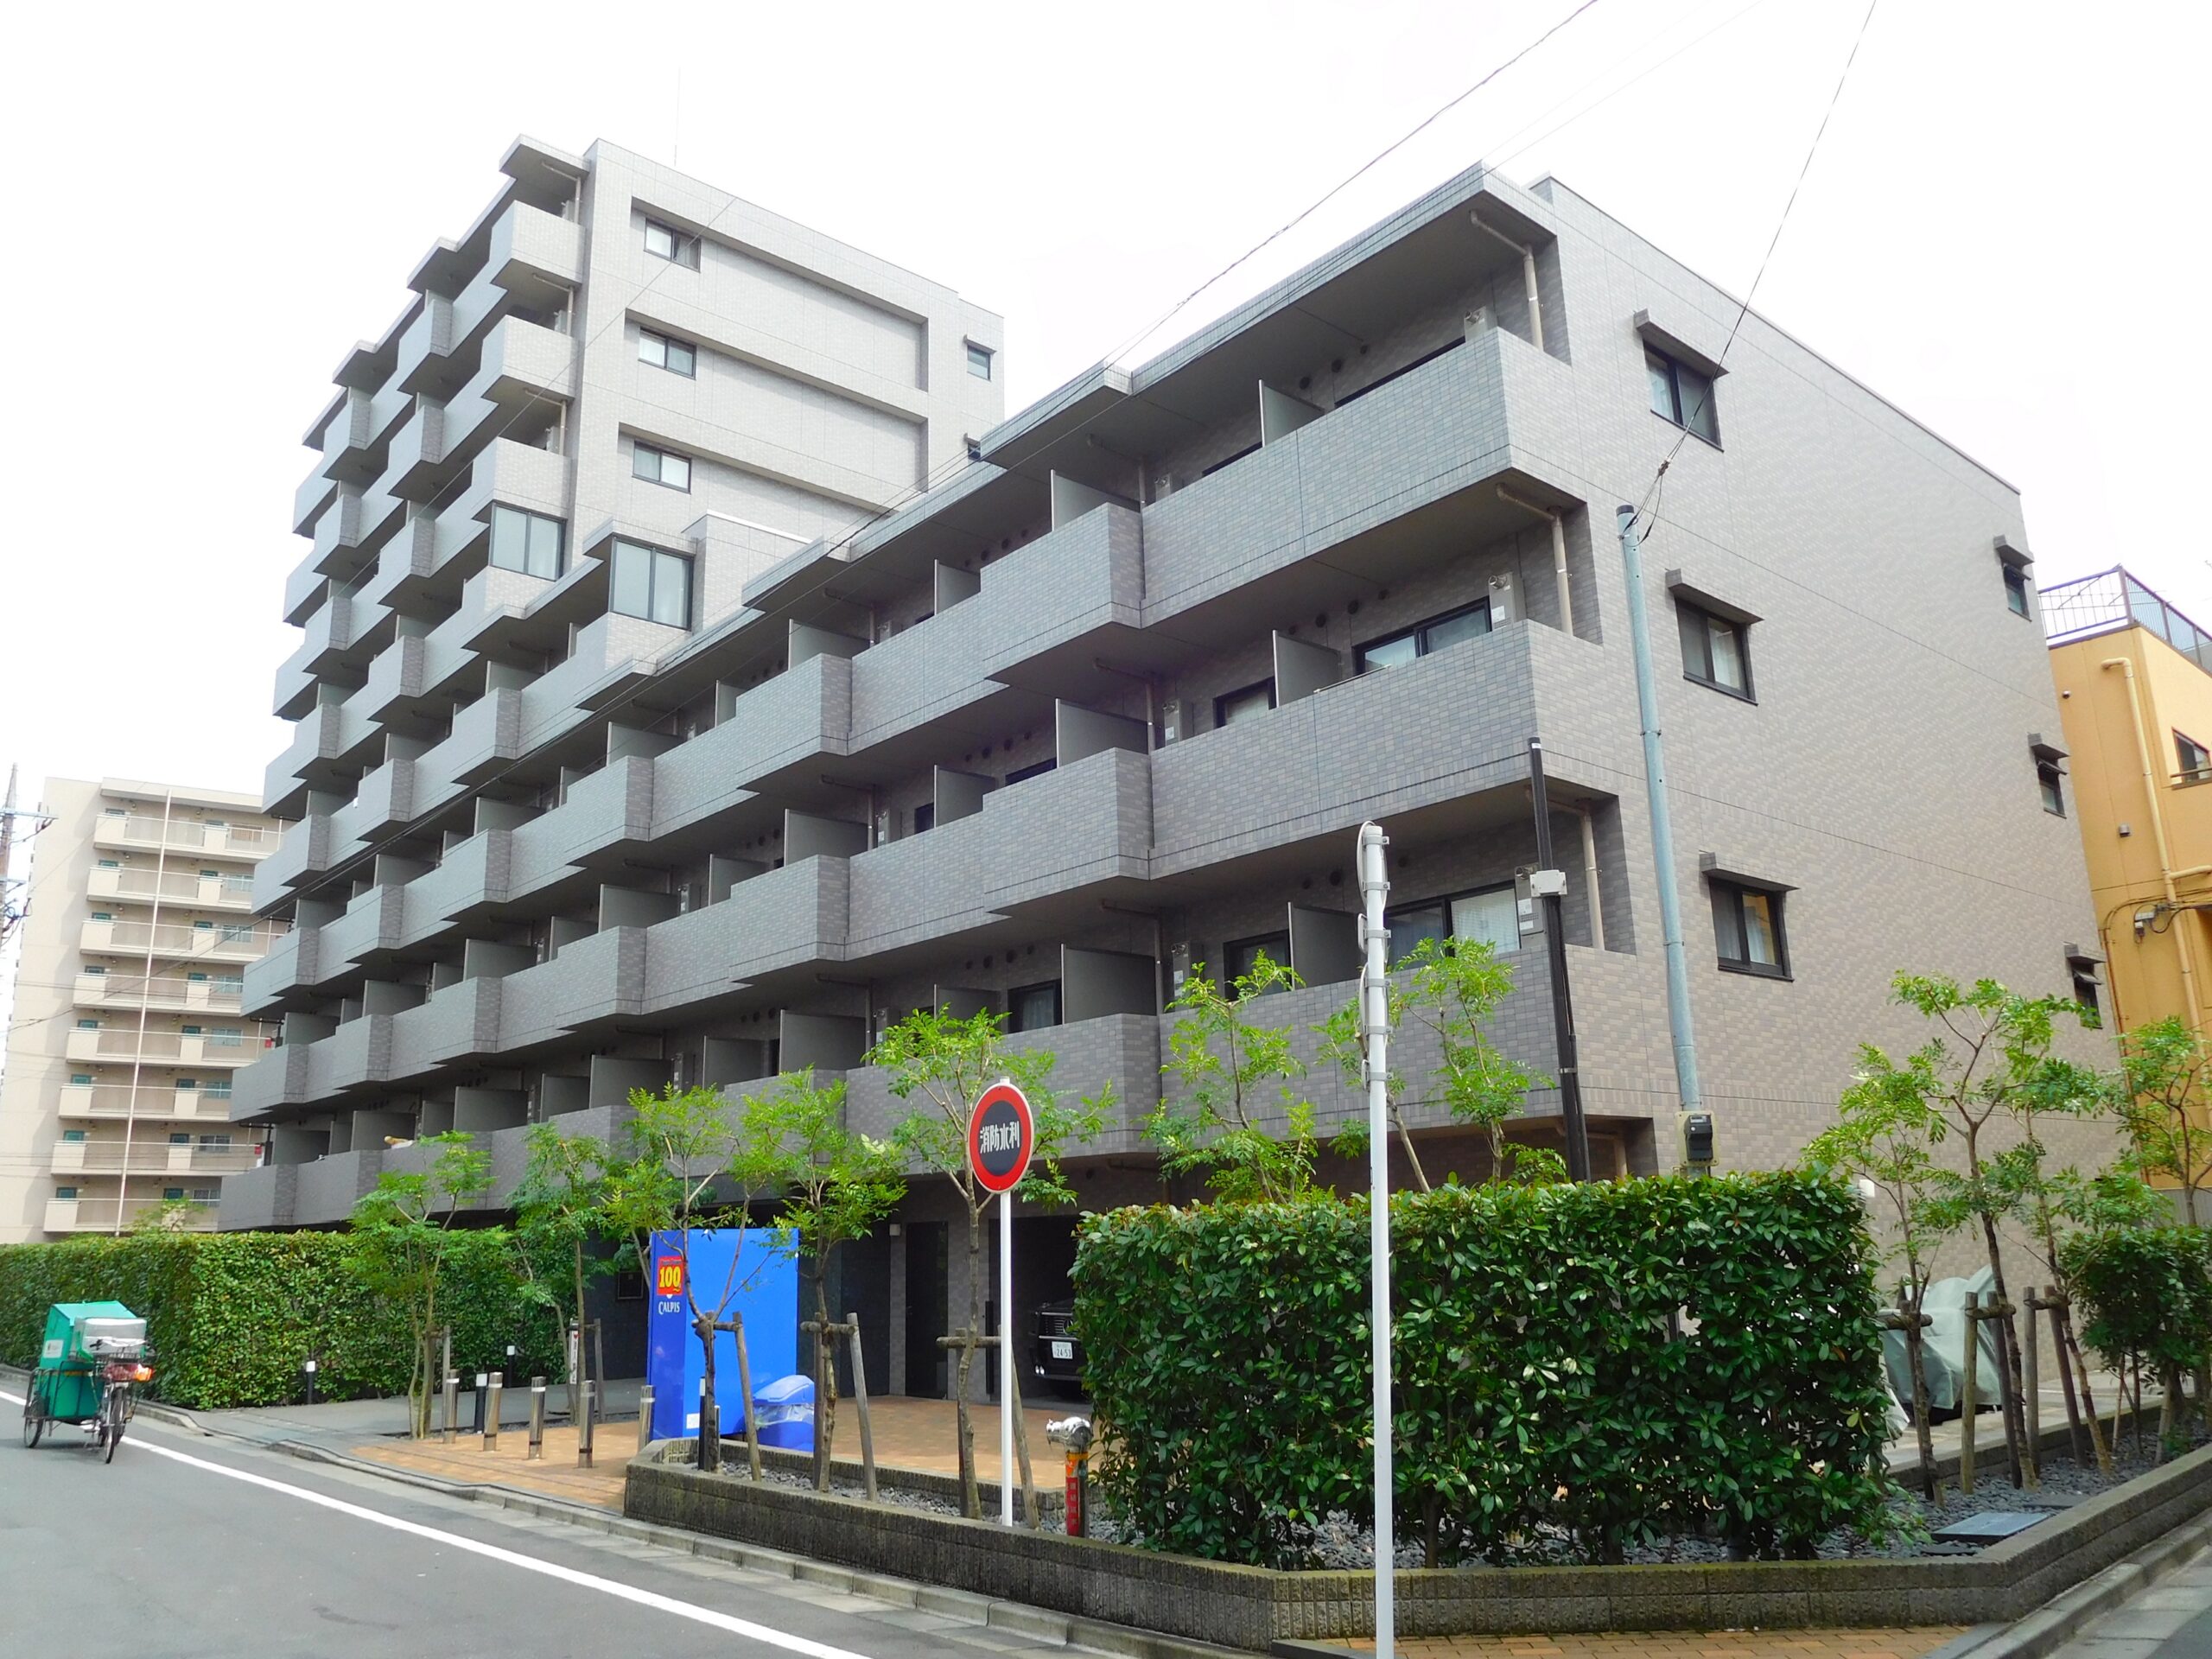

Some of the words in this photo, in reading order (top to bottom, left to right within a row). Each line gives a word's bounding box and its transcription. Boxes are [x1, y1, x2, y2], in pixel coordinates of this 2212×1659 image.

[979, 1120, 1020, 1154] 消防水利
[658, 1265, 682, 1288] 100
[658, 1300, 681, 1315] CALPIS
